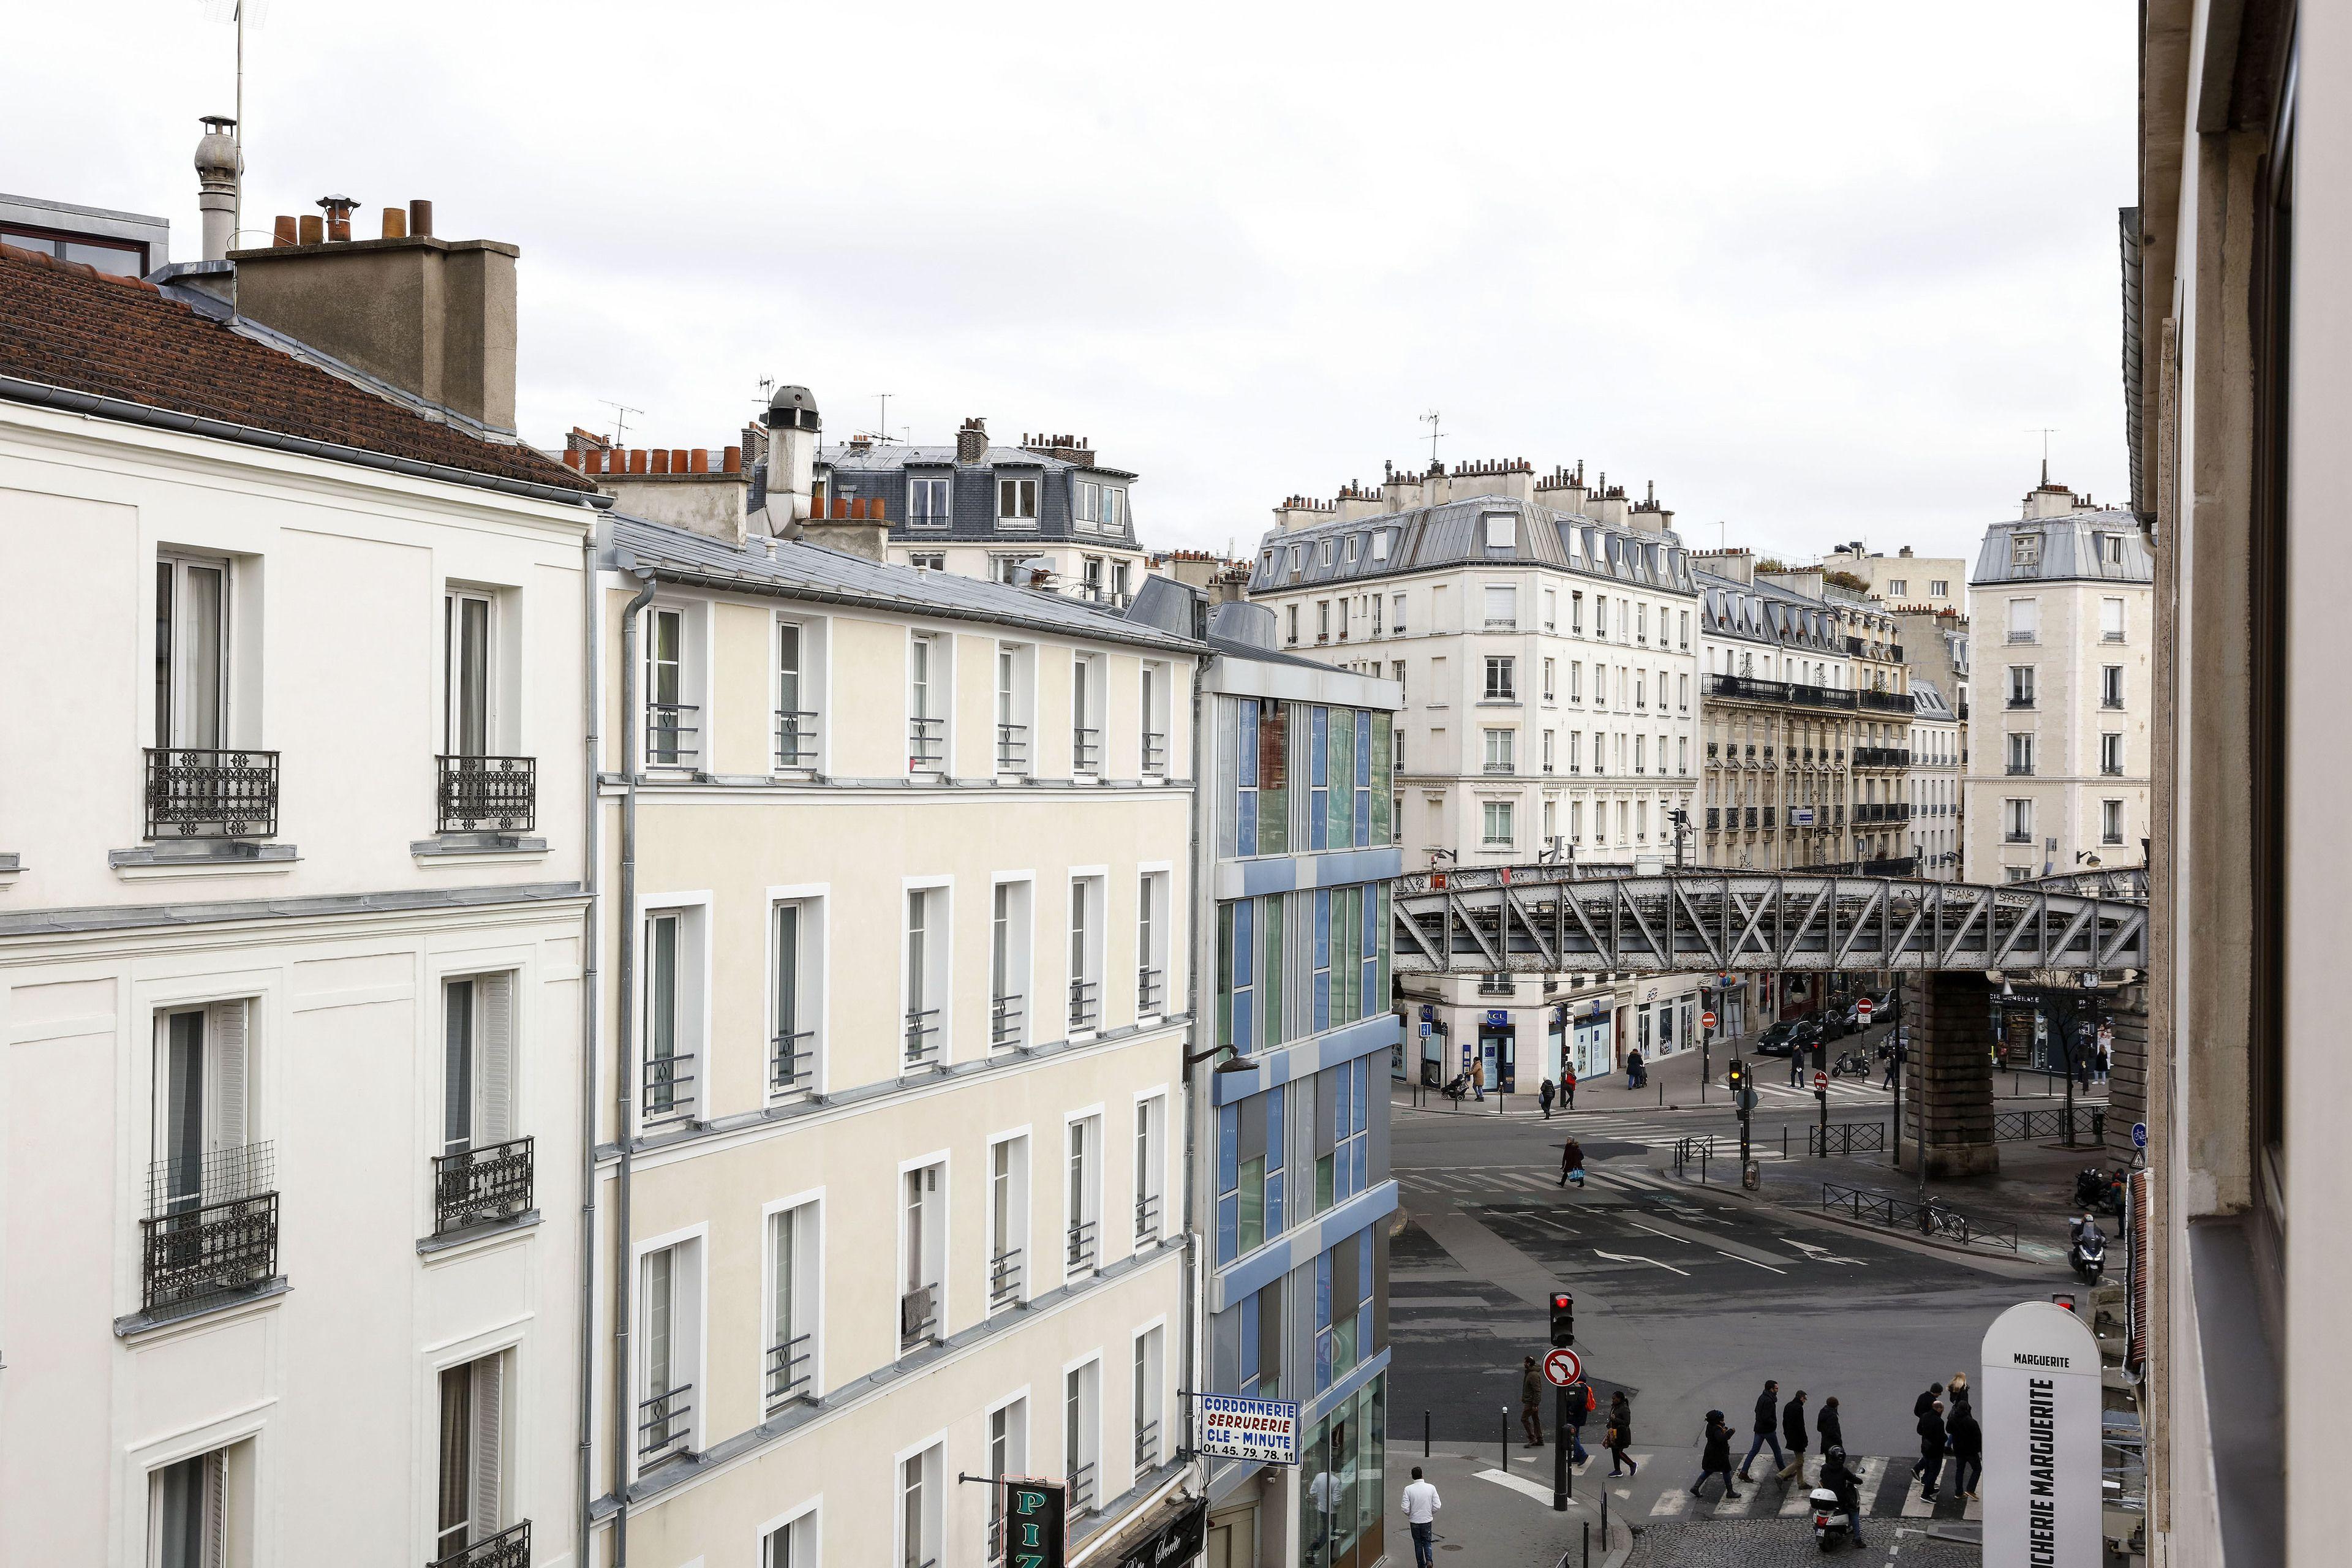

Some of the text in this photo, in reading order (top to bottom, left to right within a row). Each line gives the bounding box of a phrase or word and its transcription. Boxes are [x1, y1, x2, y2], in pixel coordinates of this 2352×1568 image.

[2014, 1353, 2070, 1368] MARGUERITE
[1205, 1397, 1294, 1419] CORDONNERIE
[1208, 1413, 1291, 1433] SERRURERIE
[1207, 1428, 1231, 1443] CLE
[1243, 1431, 1291, 1450] MINUTE
[2030, 1378, 2054, 1497] MARGUERITE
[1284, 1452, 1293, 1461] 11
